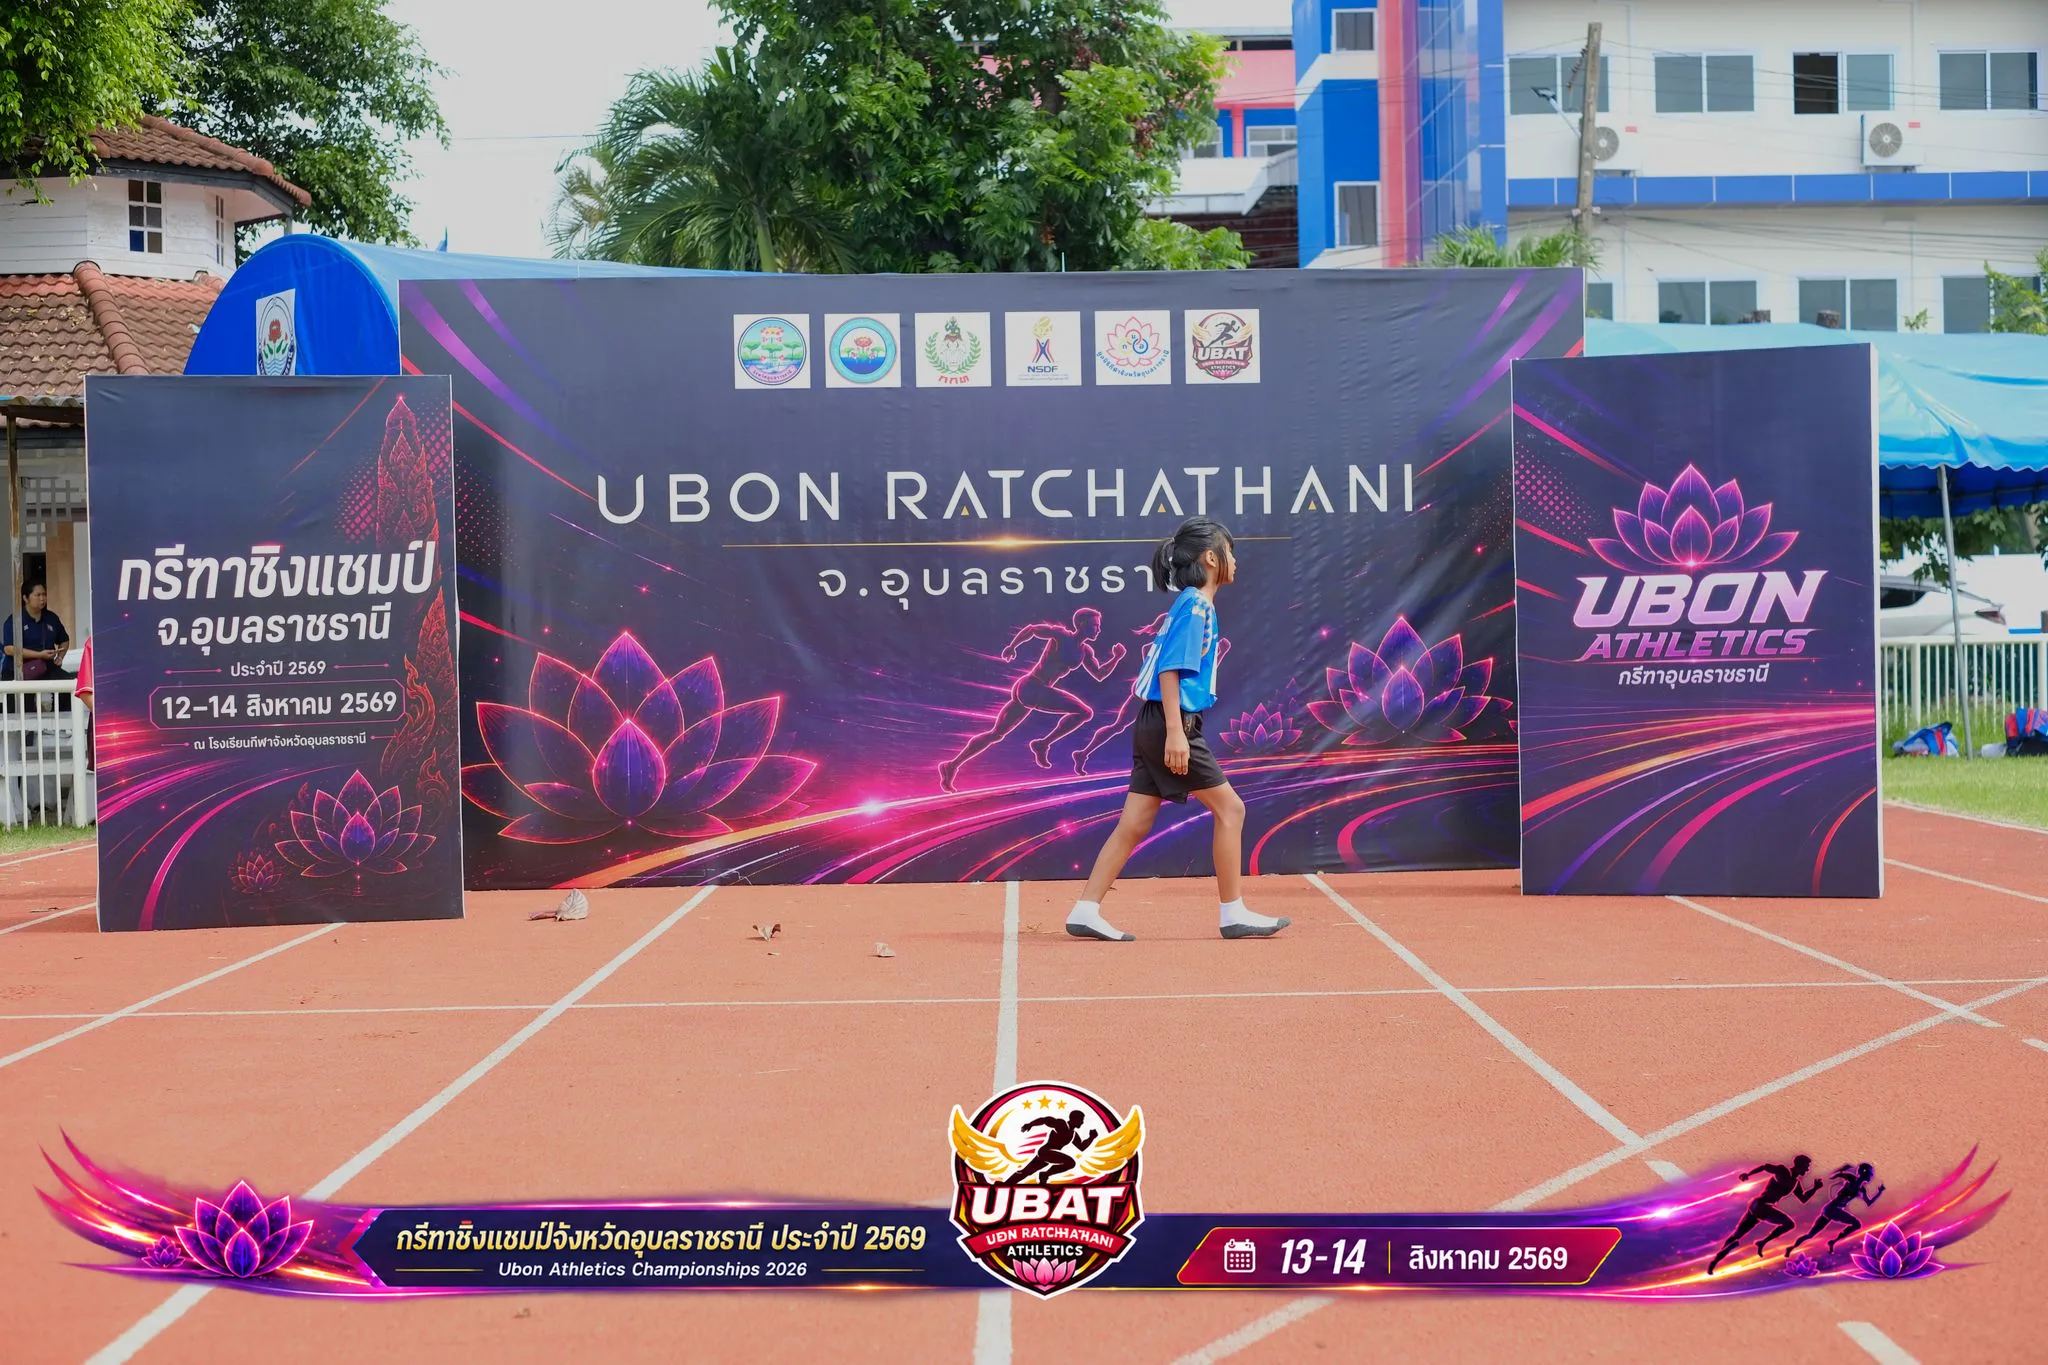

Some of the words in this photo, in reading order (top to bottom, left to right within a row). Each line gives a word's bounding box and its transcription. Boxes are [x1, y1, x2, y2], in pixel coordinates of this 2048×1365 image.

[1197, 347, 1249, 361] UBAT
[1027, 365, 1059, 373] NSDF
[597, 472, 840, 525] UBON
[887, 463, 1413, 520] RATCHATHANI
[1572, 569, 1829, 629] UBON
[157, 601, 392, 656] จ.อุบลราชธานี
[1575, 628, 1818, 662] ATHLETICS
[230, 661, 283, 677] ประจำปี
[288, 660, 327, 675] 2569
[246, 693, 332, 717] สิงหาคม
[340, 691, 397, 714] 2569
[193, 740, 206, 750] ณ
